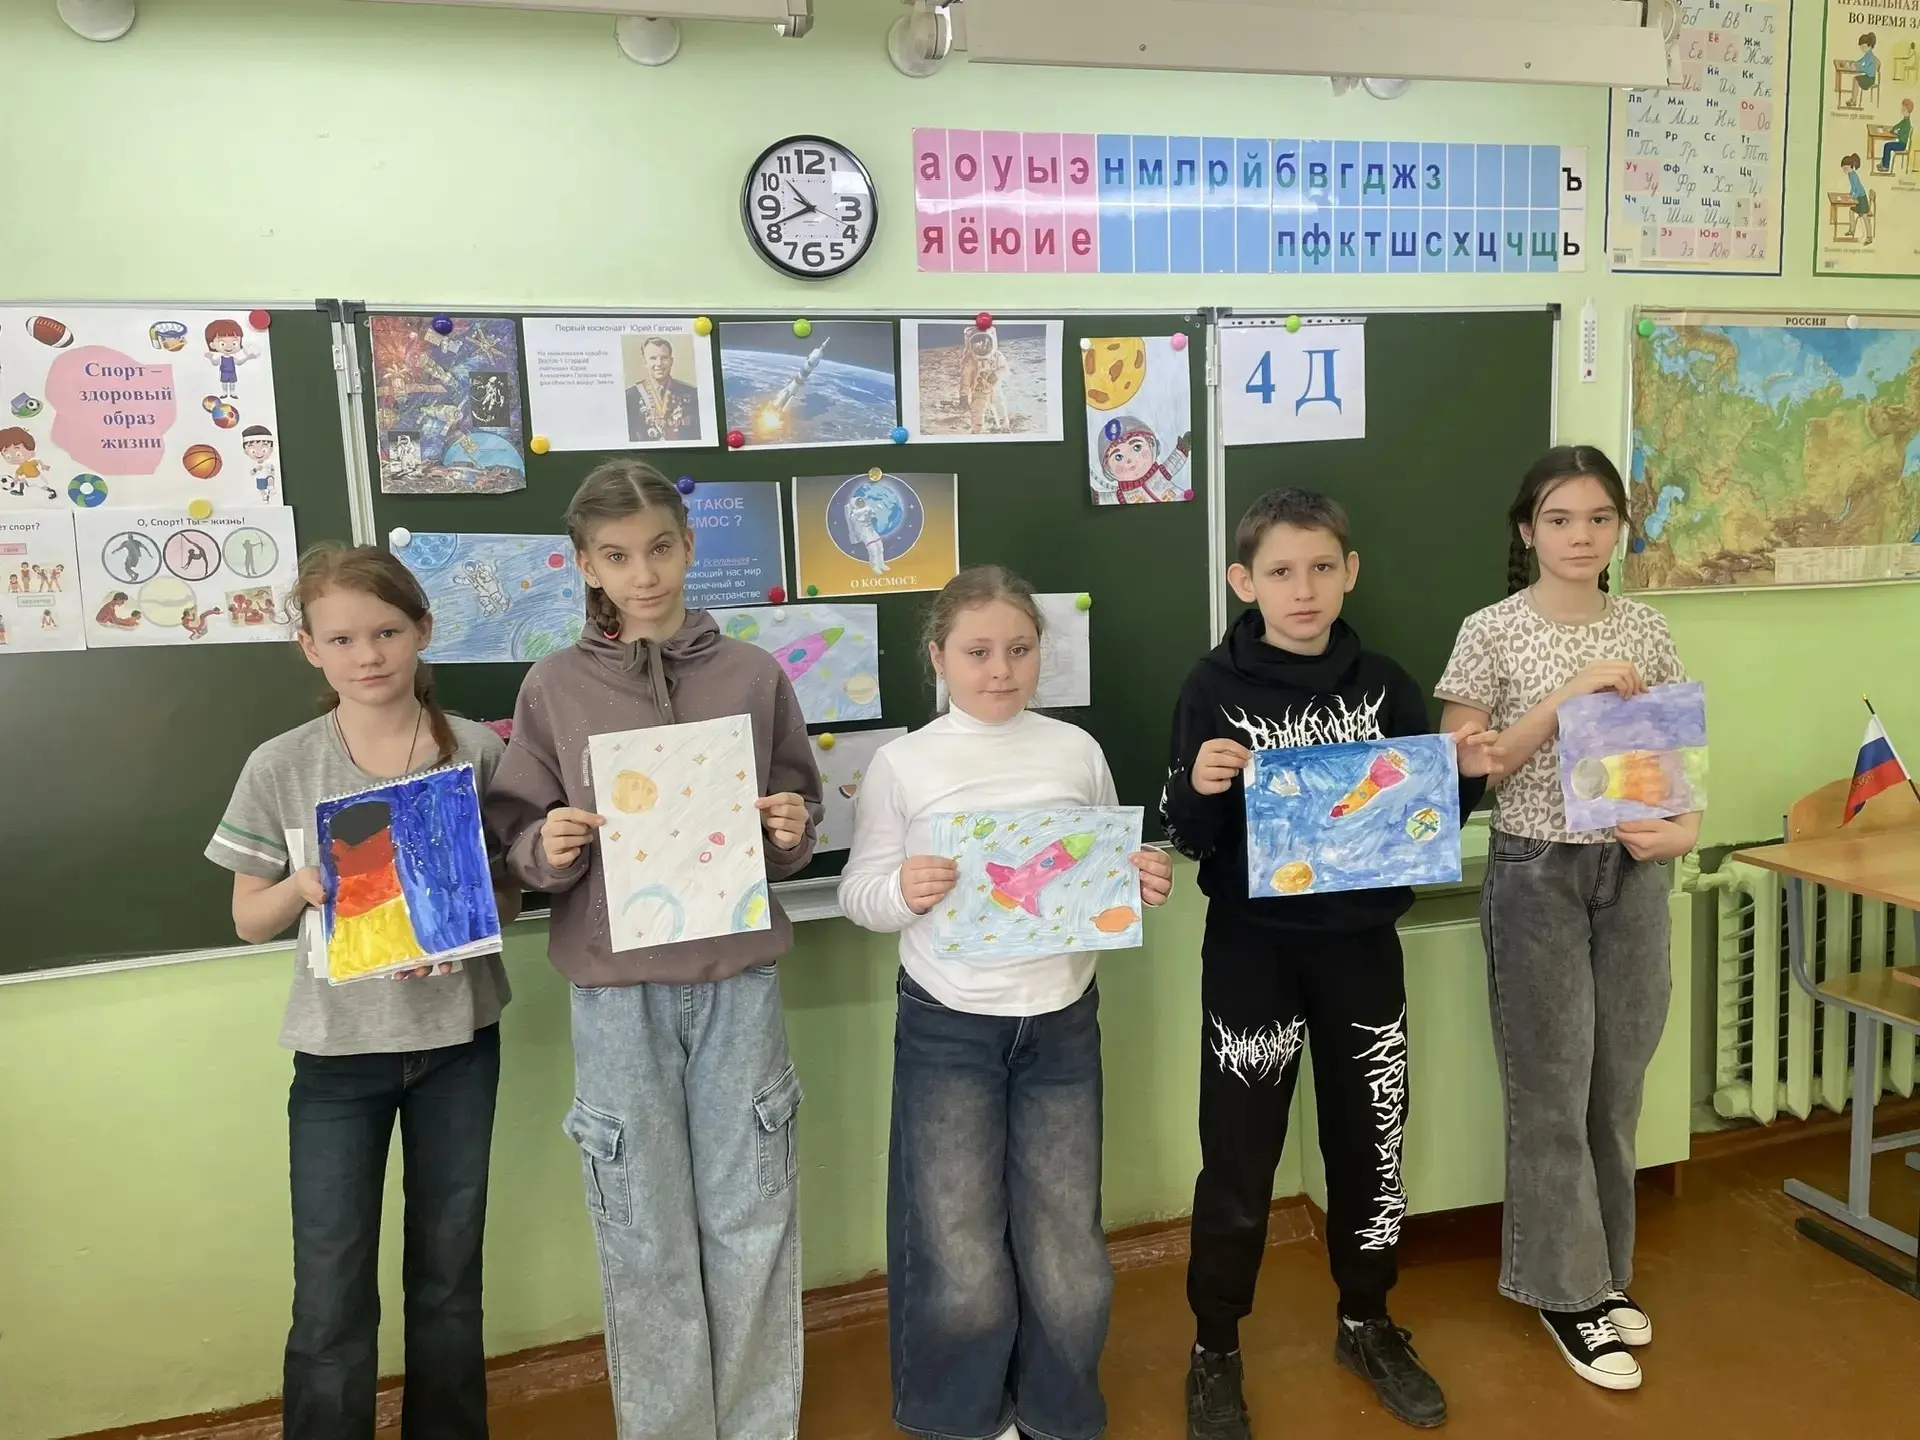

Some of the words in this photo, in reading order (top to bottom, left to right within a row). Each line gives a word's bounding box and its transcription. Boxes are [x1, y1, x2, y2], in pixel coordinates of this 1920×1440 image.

[1848, 12, 1865, 24] ВО
[1868, 13, 1906, 28] ВРЕМЯ
[1744, 37, 1761, 47] Жж
[1628, 94, 1642, 103] Лл
[1668, 97, 1684, 106] Мм
[1706, 98, 1719, 108] Нн
[1741, 100, 1754, 110] Оо
[1626, 128, 1640, 138] Пп
[1665, 130, 1678, 141] Рр
[776, 156, 791, 174] 11
[794, 149, 826, 175] 12
[829, 157, 836, 172] 1
[1663, 163, 1680, 174] Фф
[920, 151, 942, 182] а
[954, 153, 978, 182] о
[992, 154, 1013, 192] у
[1028, 157, 1058, 184] ы
[1069, 156, 1090, 185] э
[1104, 157, 1124, 185] н
[1138, 158, 1164, 186] м
[1173, 158, 1196, 186] л
[1208, 158, 1228, 194] р
[1242, 152, 1262, 189] й
[1276, 152, 1296, 189] б
[1309, 162, 1328, 189] в
[1340, 162, 1354, 189] г
[1362, 163, 1386, 195] д
[1392, 163, 1417, 190] ж
[1425, 164, 1442, 190] з
[1562, 167, 1582, 191] ъ
[760, 172, 780, 192] 10
[757, 194, 781, 220] 9
[1662, 196, 1680, 205] Шш
[840, 196, 862, 222] 3
[766, 223, 783, 243] 8
[842, 224, 858, 244] 4
[922, 225, 943, 254] я
[958, 216, 979, 254] ё
[990, 226, 1022, 255] ю
[1034, 226, 1055, 255] и
[1070, 226, 1092, 256] е
[1278, 231, 1296, 257] п
[1302, 222, 1331, 265] ф
[1340, 232, 1356, 257] к
[1364, 232, 1382, 257] т
[1392, 232, 1417, 257] ш
[1425, 232, 1442, 258] с
[1453, 232, 1470, 257] х
[1478, 232, 1497, 262] ц
[1506, 232, 1522, 257] ч
[1532, 232, 1558, 262] щ
[1563, 232, 1580, 256] ь
[1700, 230, 1719, 238] Юю
[783, 242, 798, 260] 7
[802, 242, 825, 267] 6
[829, 242, 845, 260] 5
[555, 324, 586, 332] Первый
[630, 324, 652, 332] Юрий
[1785, 317, 1826, 326] РОССИЯ
[85, 362, 147, 382] Спорт
[1245, 350, 1276, 404] 4
[1295, 348, 1342, 417] Д
[78, 387, 172, 406] здоровый
[102, 411, 156, 430] образ
[100, 436, 162, 449] жизни
[696, 497, 744, 510] ТАКОЕ
[9, 522, 40, 532] спорт?
[137, 518, 148, 528] О,
[151, 518, 183, 529] Спорт!
[186, 518, 200, 526] Ты
[210, 517, 246, 525] жизнь!
[744, 567, 762, 576] мир
[734, 580, 745, 588] во
[850, 580, 859, 588] О
[861, 575, 917, 588] КОСМОСЕ
[701, 590, 761, 602] пространстве
